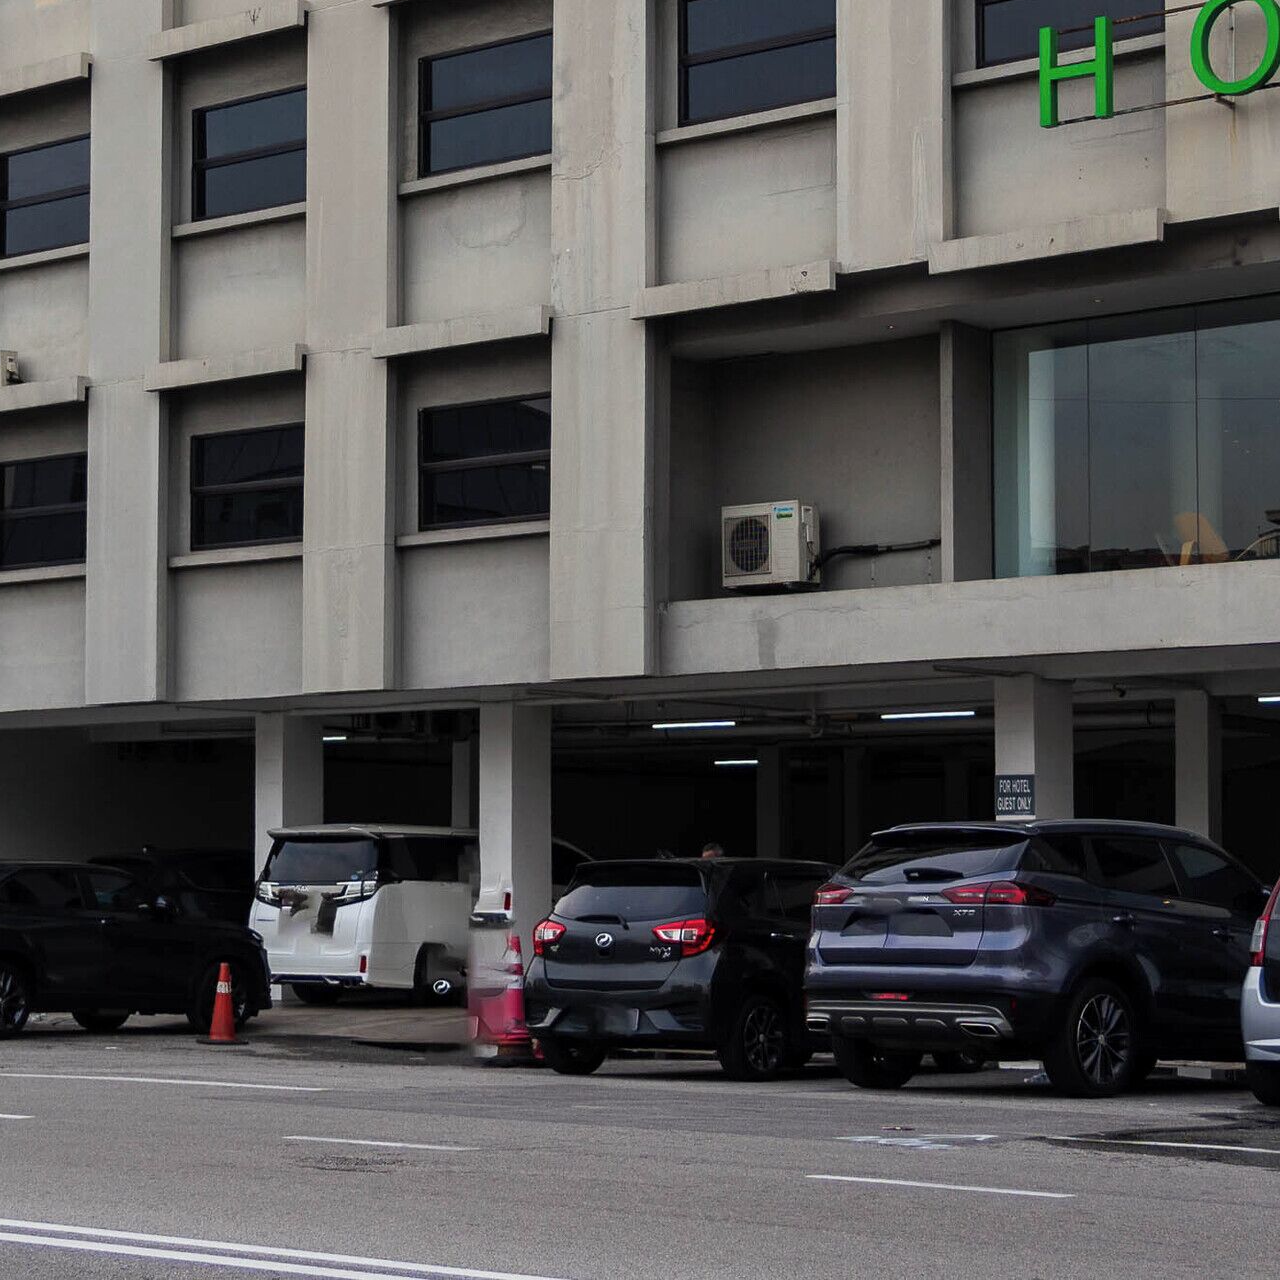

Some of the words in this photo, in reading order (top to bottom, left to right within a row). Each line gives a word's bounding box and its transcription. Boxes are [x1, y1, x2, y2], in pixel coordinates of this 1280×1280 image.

[999, 779, 1011, 793] FOR
[1012, 779, 1030, 793] HOTEL
[997, 796, 1016, 810] GUEST
[1017, 796, 1032, 810] ONLY
